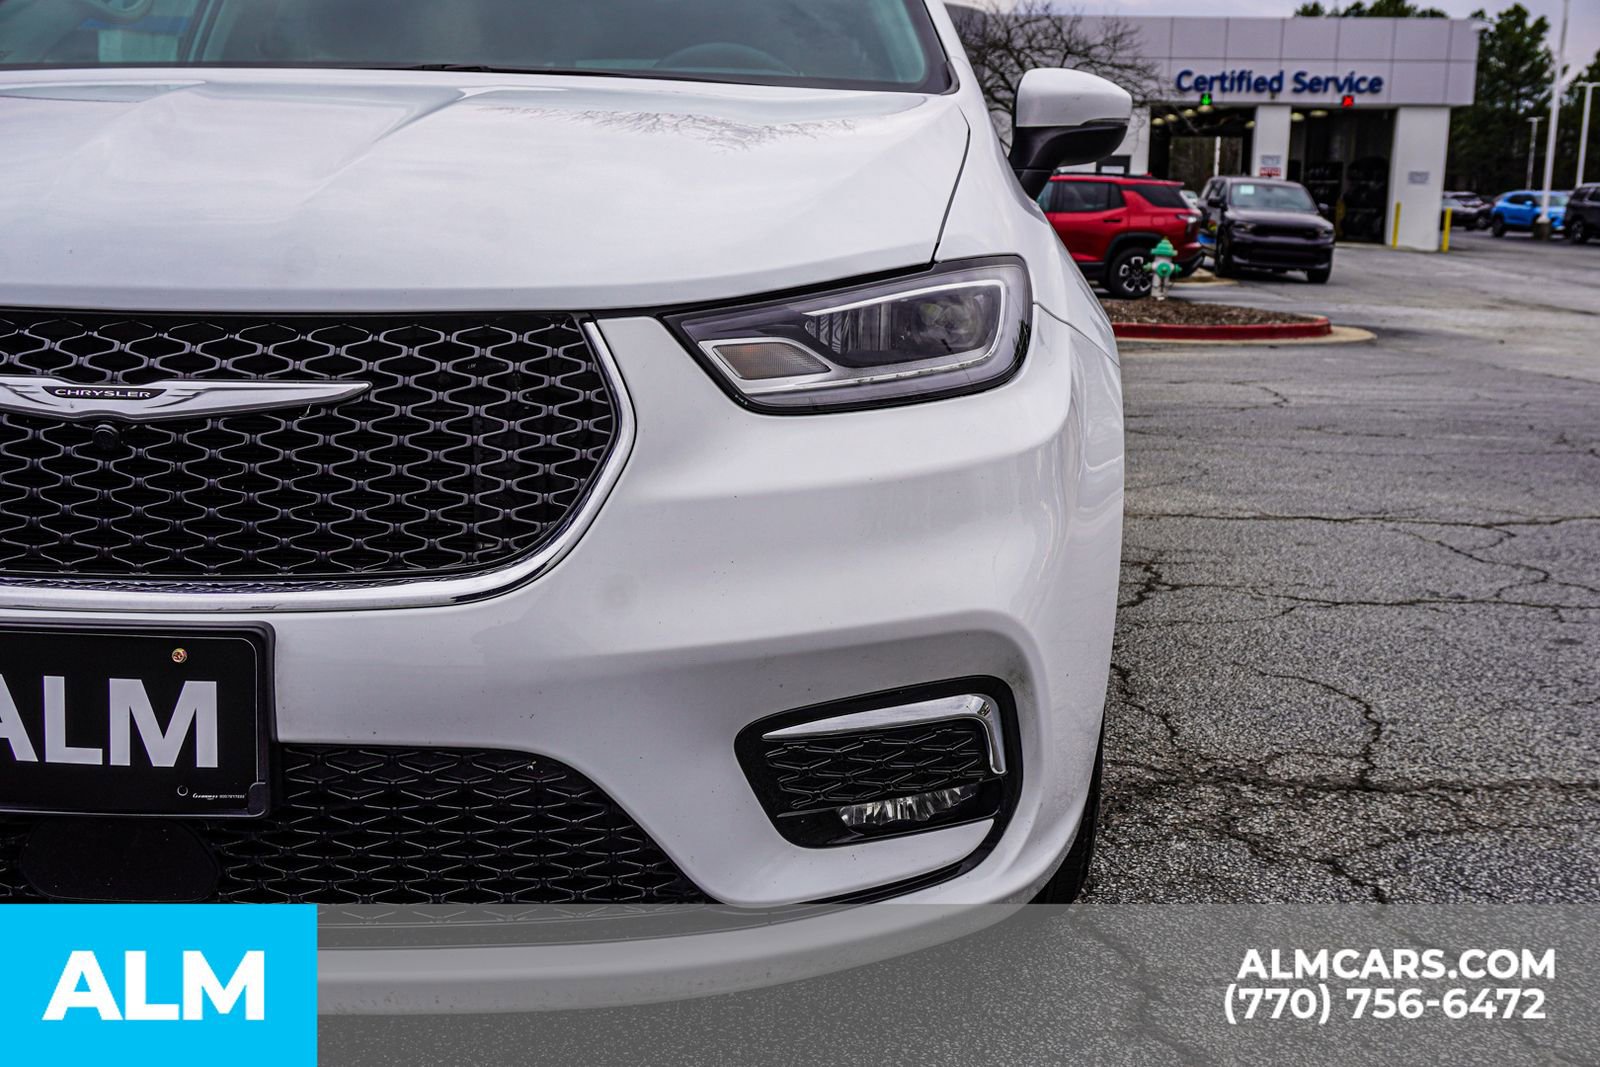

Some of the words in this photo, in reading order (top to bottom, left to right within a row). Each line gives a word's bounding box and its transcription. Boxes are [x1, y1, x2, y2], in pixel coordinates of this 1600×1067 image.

[1176, 69, 1284, 93] Certified
[1292, 71, 1383, 94] Service
[54, 388, 151, 398] CHRYSLER
